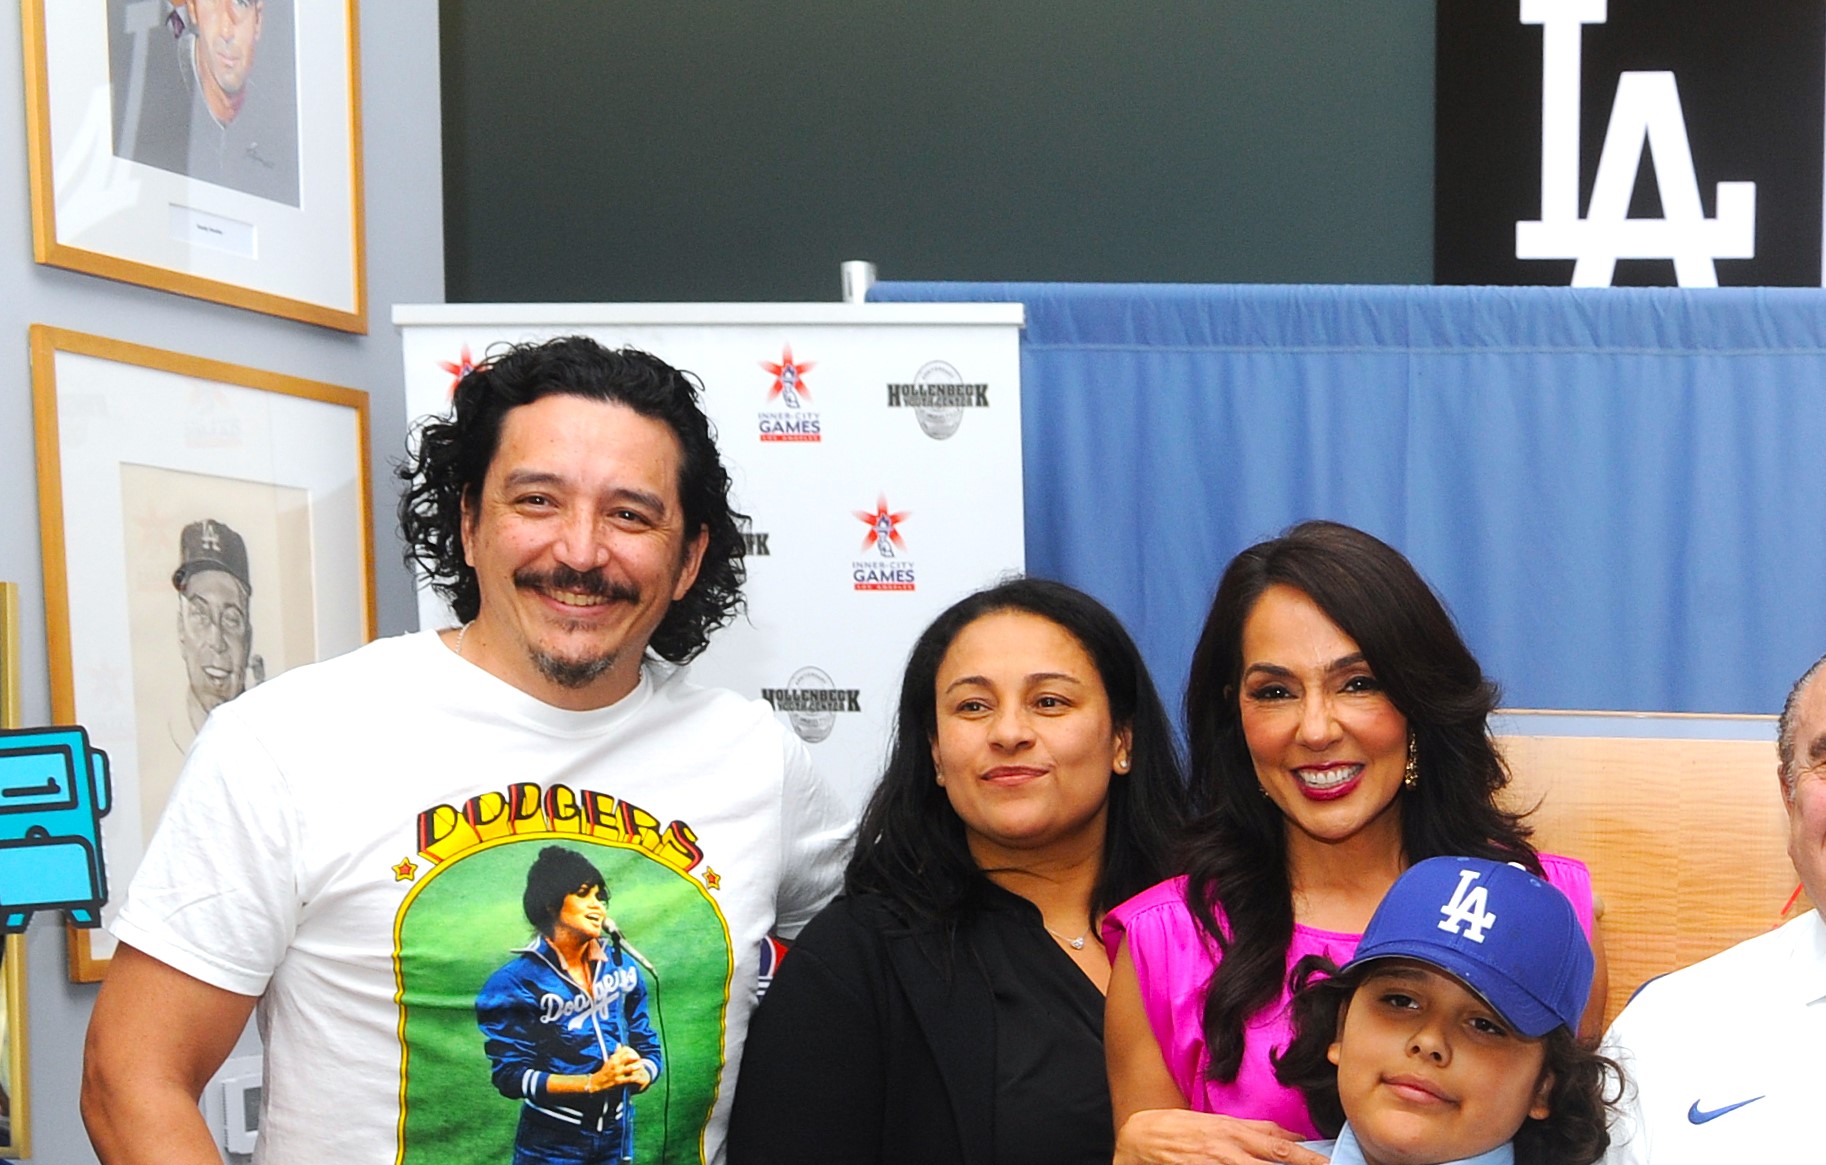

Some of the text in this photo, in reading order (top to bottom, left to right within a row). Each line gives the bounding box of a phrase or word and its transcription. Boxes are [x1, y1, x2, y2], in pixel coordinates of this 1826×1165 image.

[1515, 0, 1756, 288] LA
[887, 383, 989, 407] HOLLENBECK
[759, 420, 820, 433] GAMES
[853, 569, 915, 582] GAMES
[416, 782, 704, 871] DODGERS
[1437, 869, 1496, 944] LA
[540, 966, 638, 1025] Dodgers
